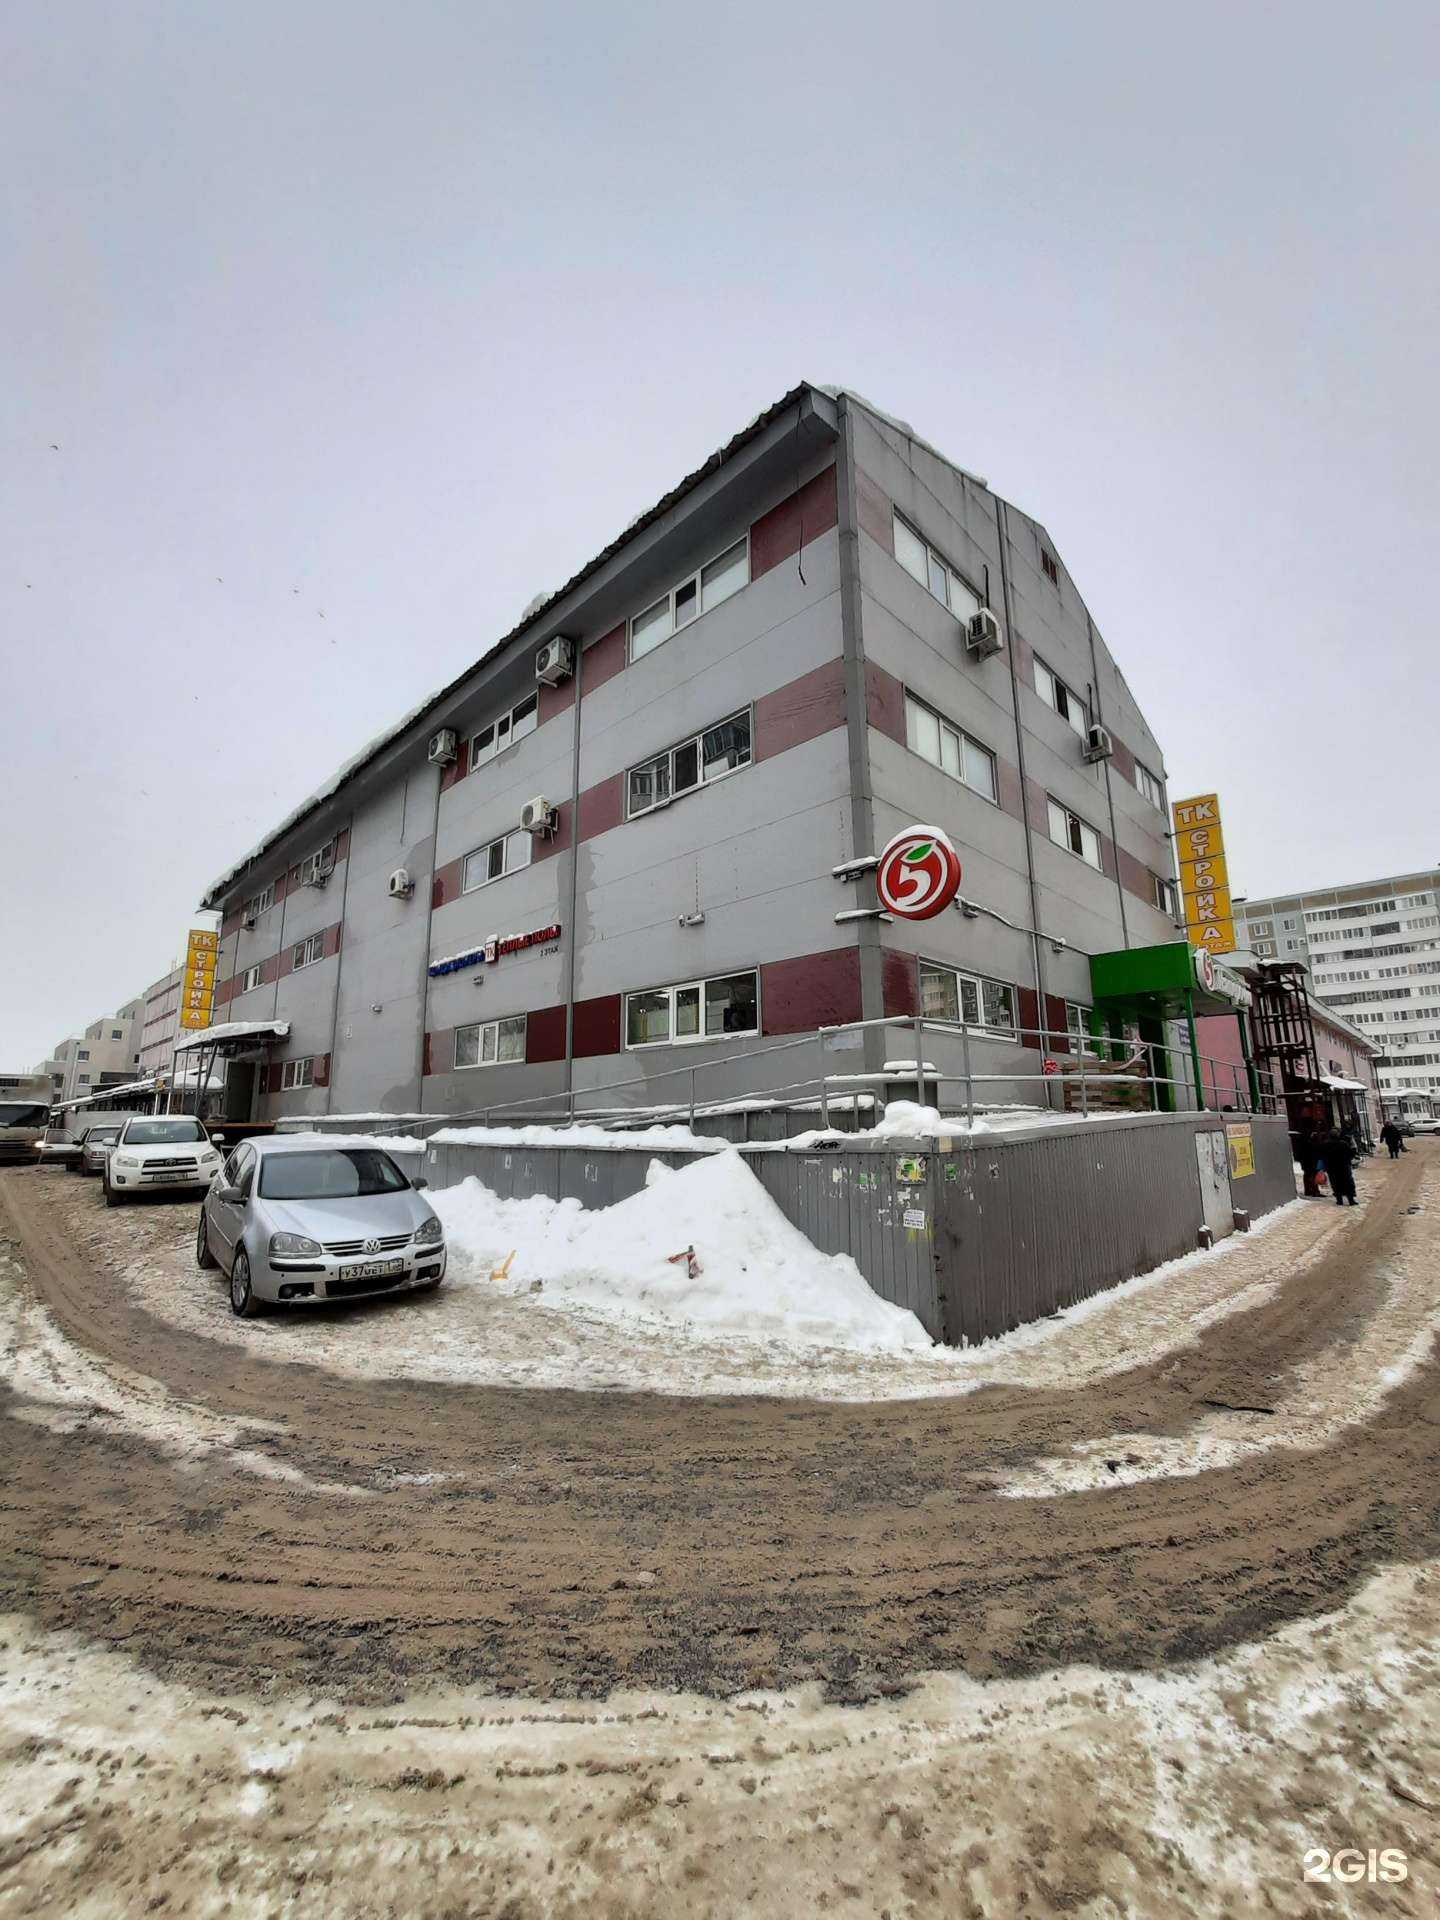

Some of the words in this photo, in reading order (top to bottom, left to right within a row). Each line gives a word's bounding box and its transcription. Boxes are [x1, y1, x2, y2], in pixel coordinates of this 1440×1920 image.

[1178, 801, 1216, 824] ТК
[894, 842, 936, 908] 5
[192, 935, 212, 946] ТК
